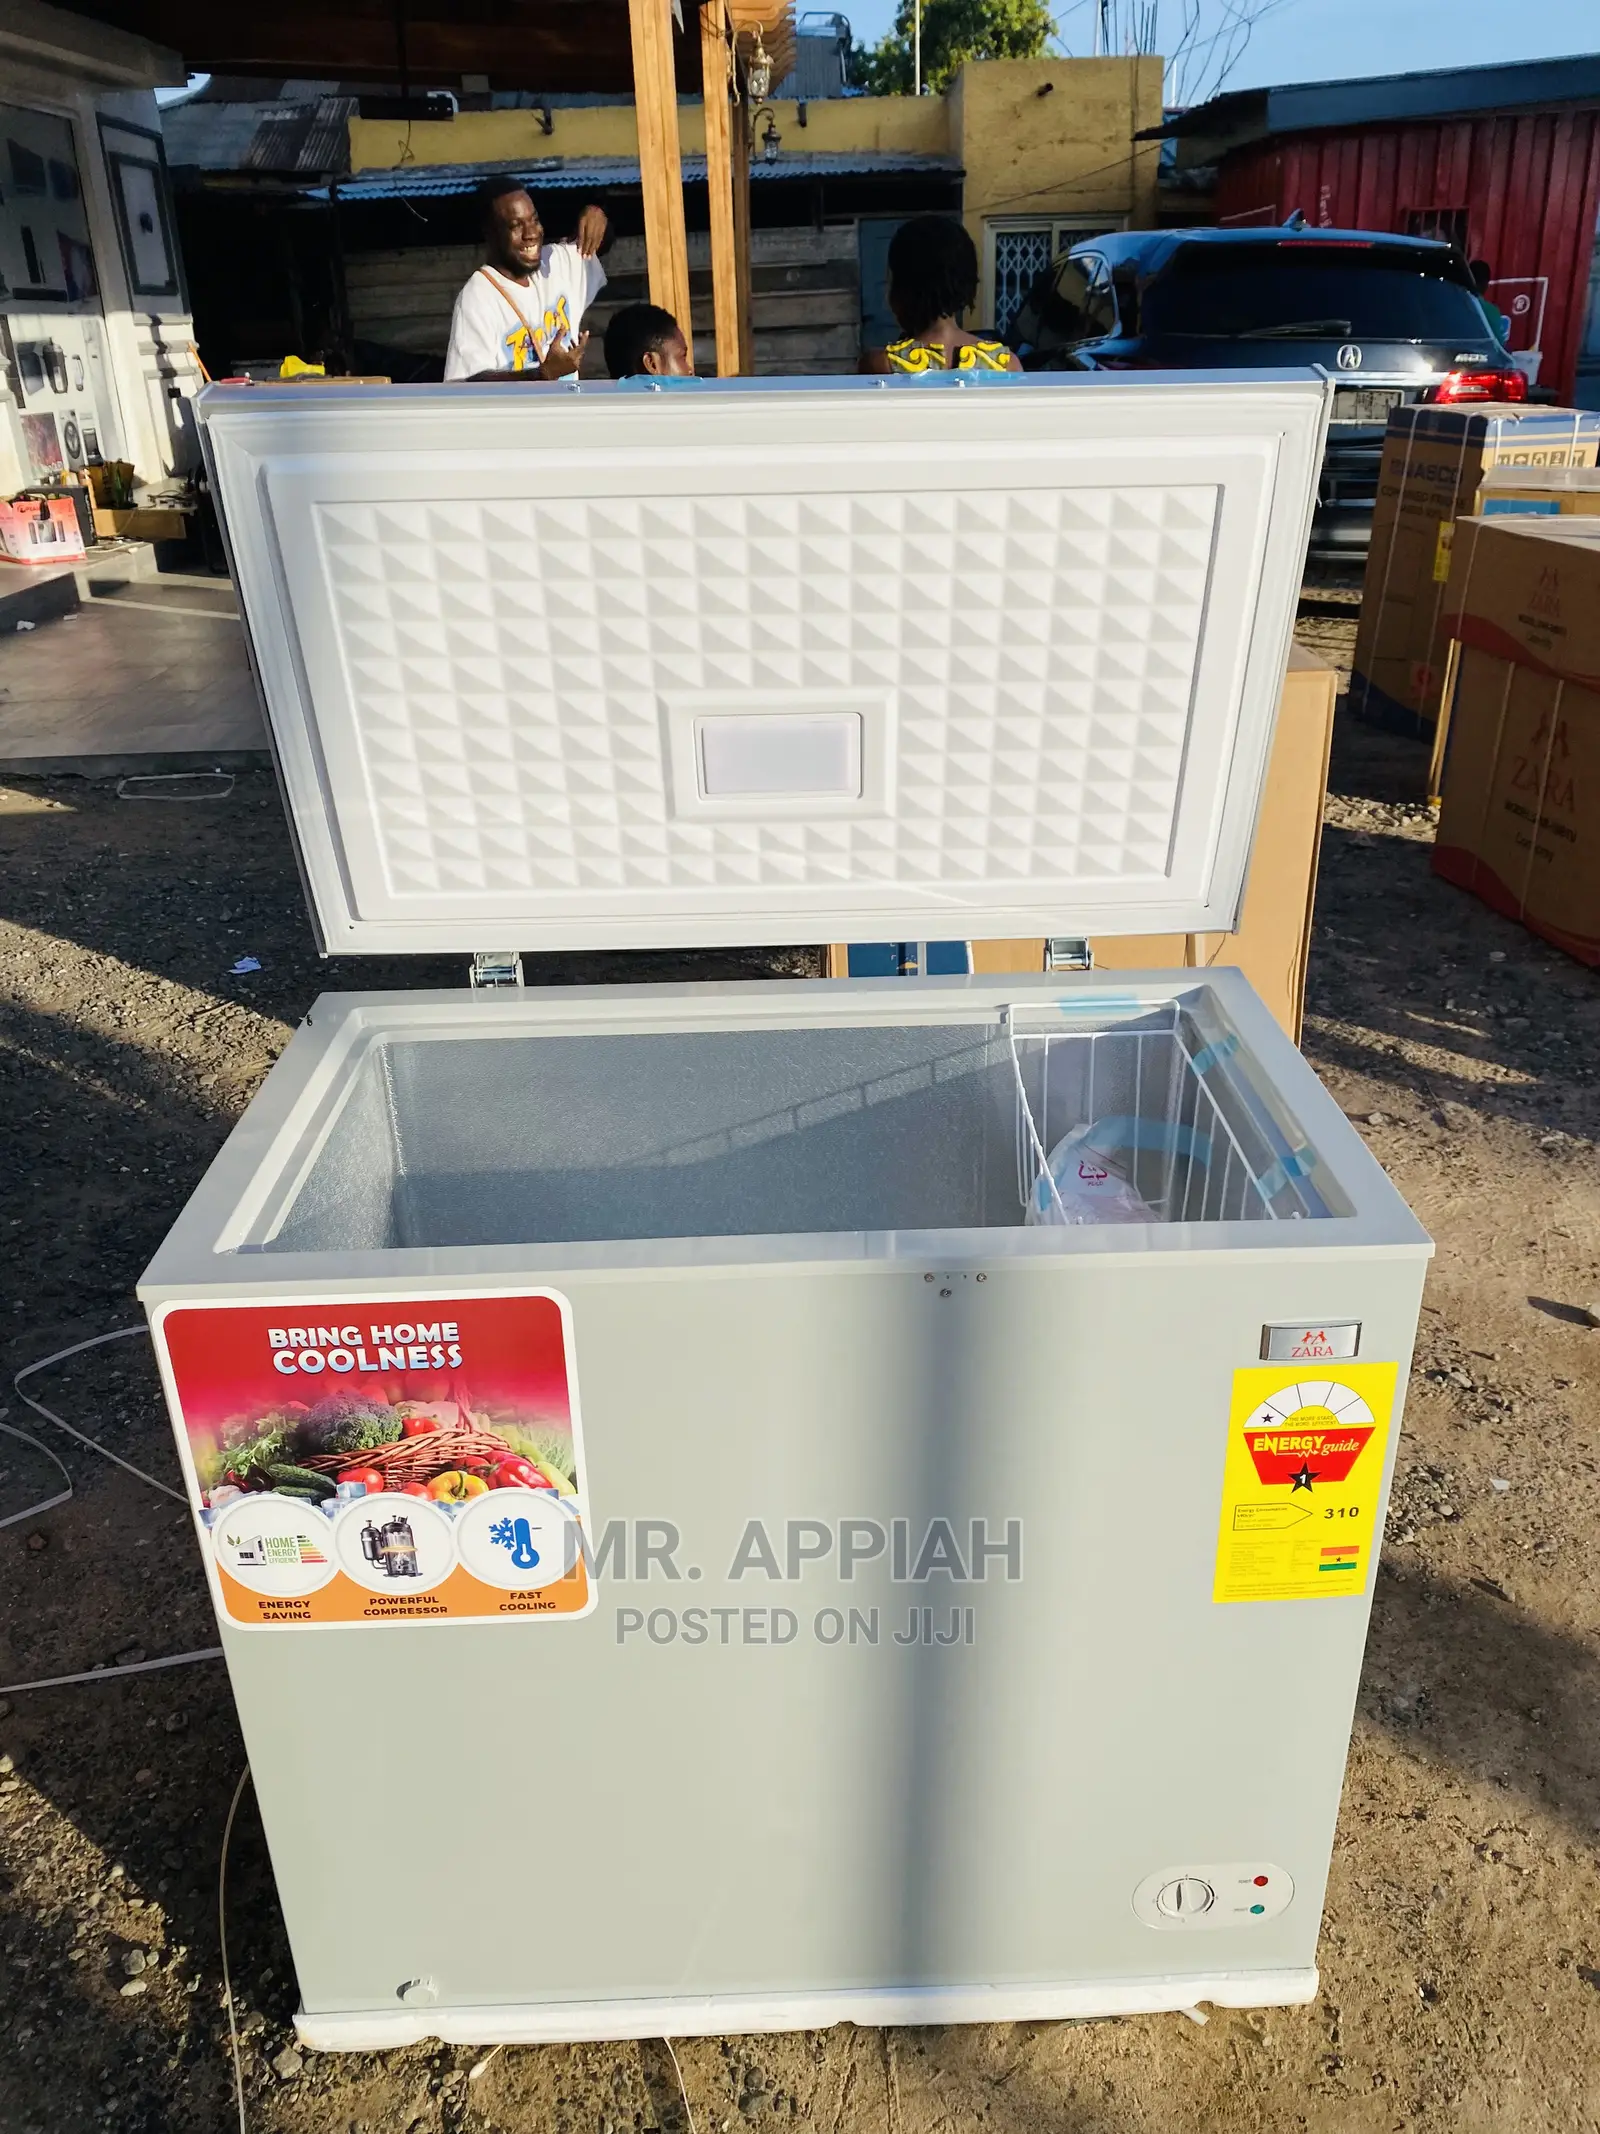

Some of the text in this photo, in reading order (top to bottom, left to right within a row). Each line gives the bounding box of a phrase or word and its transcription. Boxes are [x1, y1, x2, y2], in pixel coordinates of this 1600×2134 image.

[268, 1322, 460, 1348] BRING HOME
[1291, 1346, 1334, 1358] ZARA
[273, 1343, 463, 1374] COOLNESS
[1253, 1433, 1361, 1456] ENERGY guide
[1300, 1473, 1307, 1485] 1
[1324, 1506, 1360, 1519] 310
[264, 1537, 297, 1549] HOME
[267, 1548, 298, 1557] ENERGY
[369, 1595, 439, 1606] POWERFUL
[509, 1591, 542, 1600] FAST
[258, 1600, 311, 1610] ENERGY
[363, 1605, 448, 1616] COMPRESSOR
[499, 1601, 556, 1611] COOLING
[263, 1611, 312, 1620] SAVING
